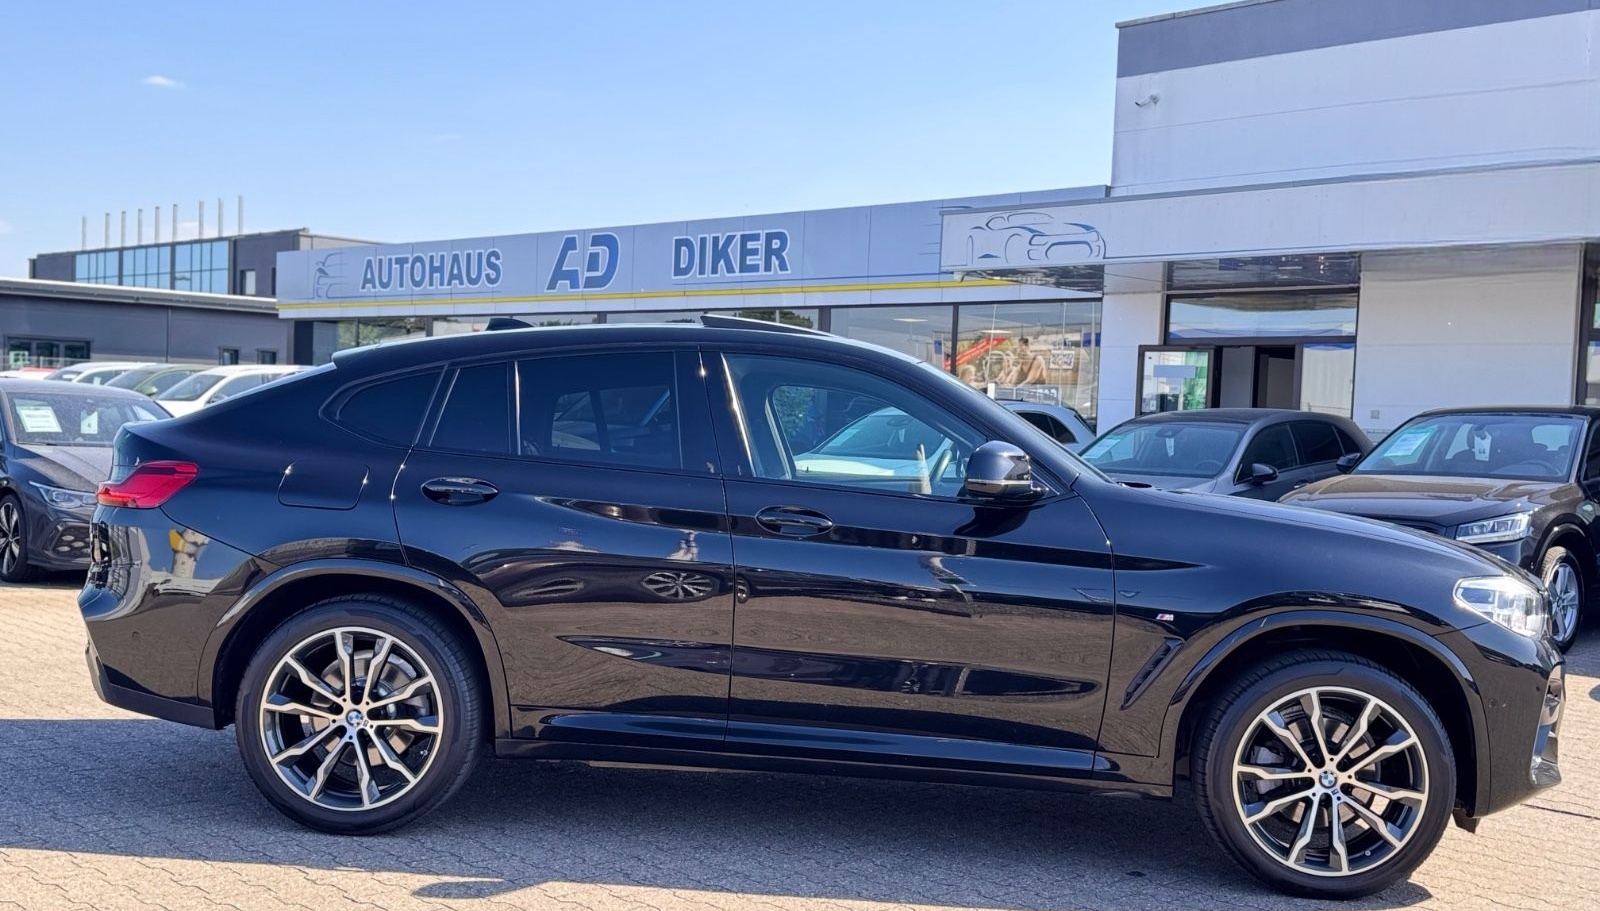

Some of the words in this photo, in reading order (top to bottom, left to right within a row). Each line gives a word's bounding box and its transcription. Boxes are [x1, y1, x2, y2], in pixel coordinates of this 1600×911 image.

[360, 249, 502, 291] AUTOHAUS
[544, 232, 620, 292] AD
[672, 229, 791, 279] DIKER
